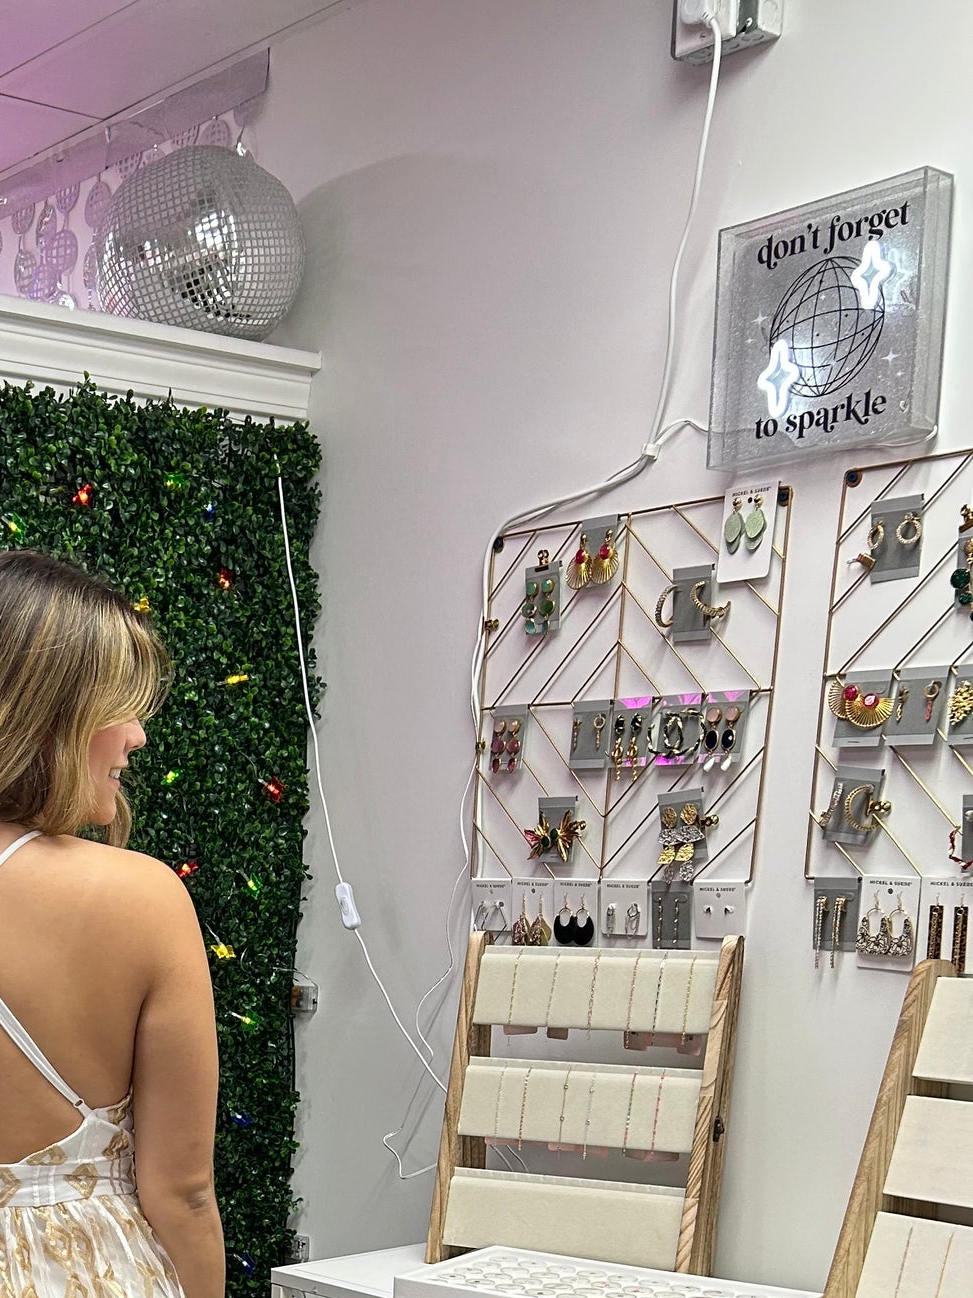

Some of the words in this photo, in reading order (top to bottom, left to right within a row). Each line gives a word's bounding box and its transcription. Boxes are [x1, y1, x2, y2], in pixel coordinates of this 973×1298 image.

[757, 223, 820, 270] don't
[823, 201, 911, 255] forget
[755, 417, 778, 439] to
[785, 387, 887, 439] sparkle
